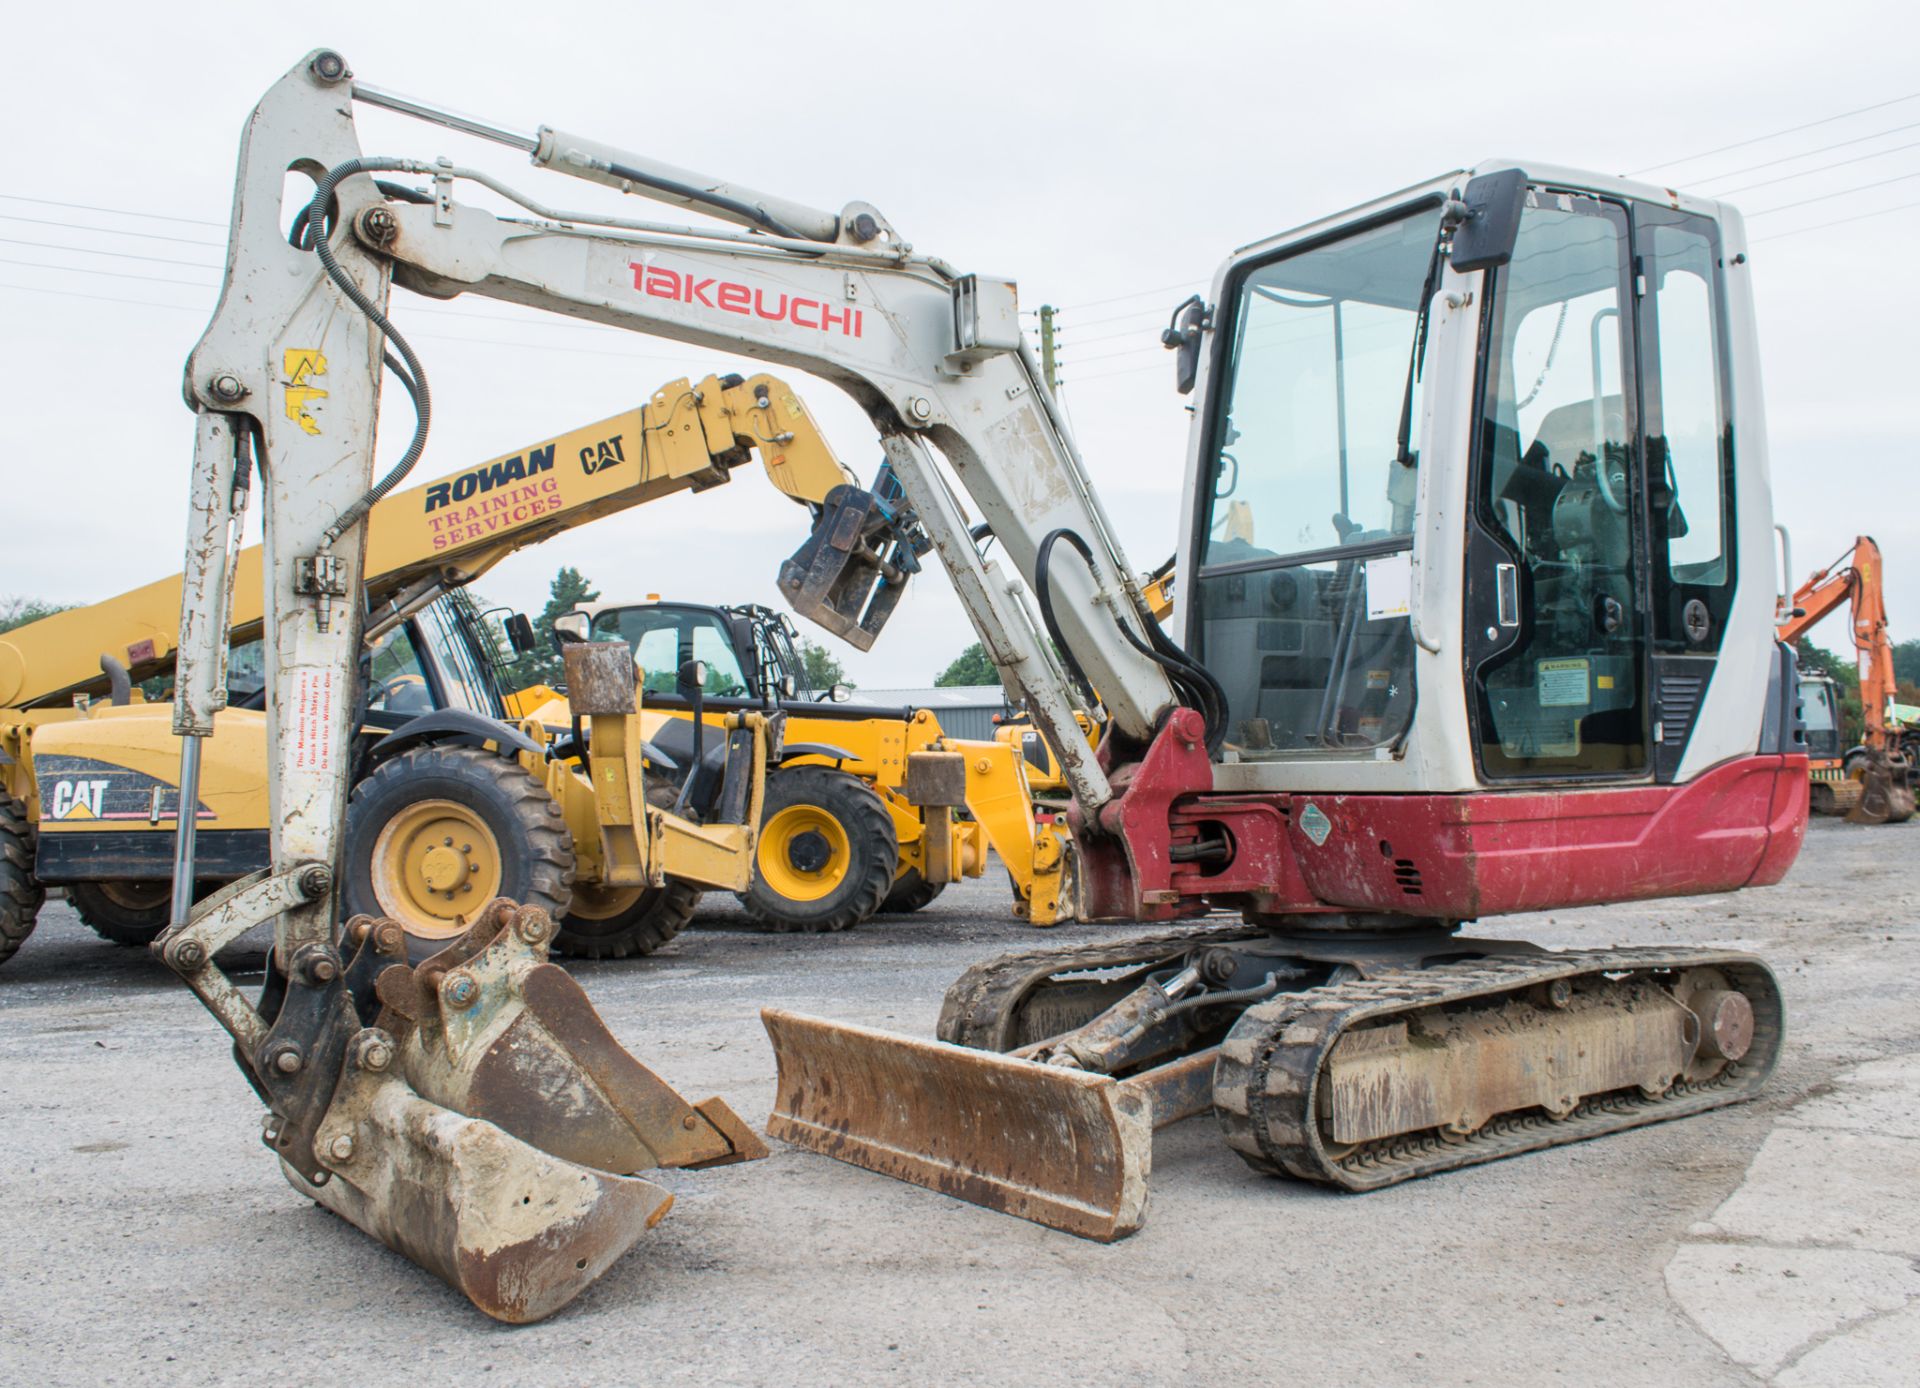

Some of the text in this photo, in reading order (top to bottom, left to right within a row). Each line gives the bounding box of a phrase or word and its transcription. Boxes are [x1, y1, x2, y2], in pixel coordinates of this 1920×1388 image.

[579, 434, 625, 476] CAT
[425, 443, 556, 513] ROWAN
[428, 477, 559, 532] TRAINING
[432, 494, 563, 550] SERVICES
[299, 680, 307, 713] Requires
[297, 716, 305, 749] Machine
[52, 780, 111, 819] CAT
